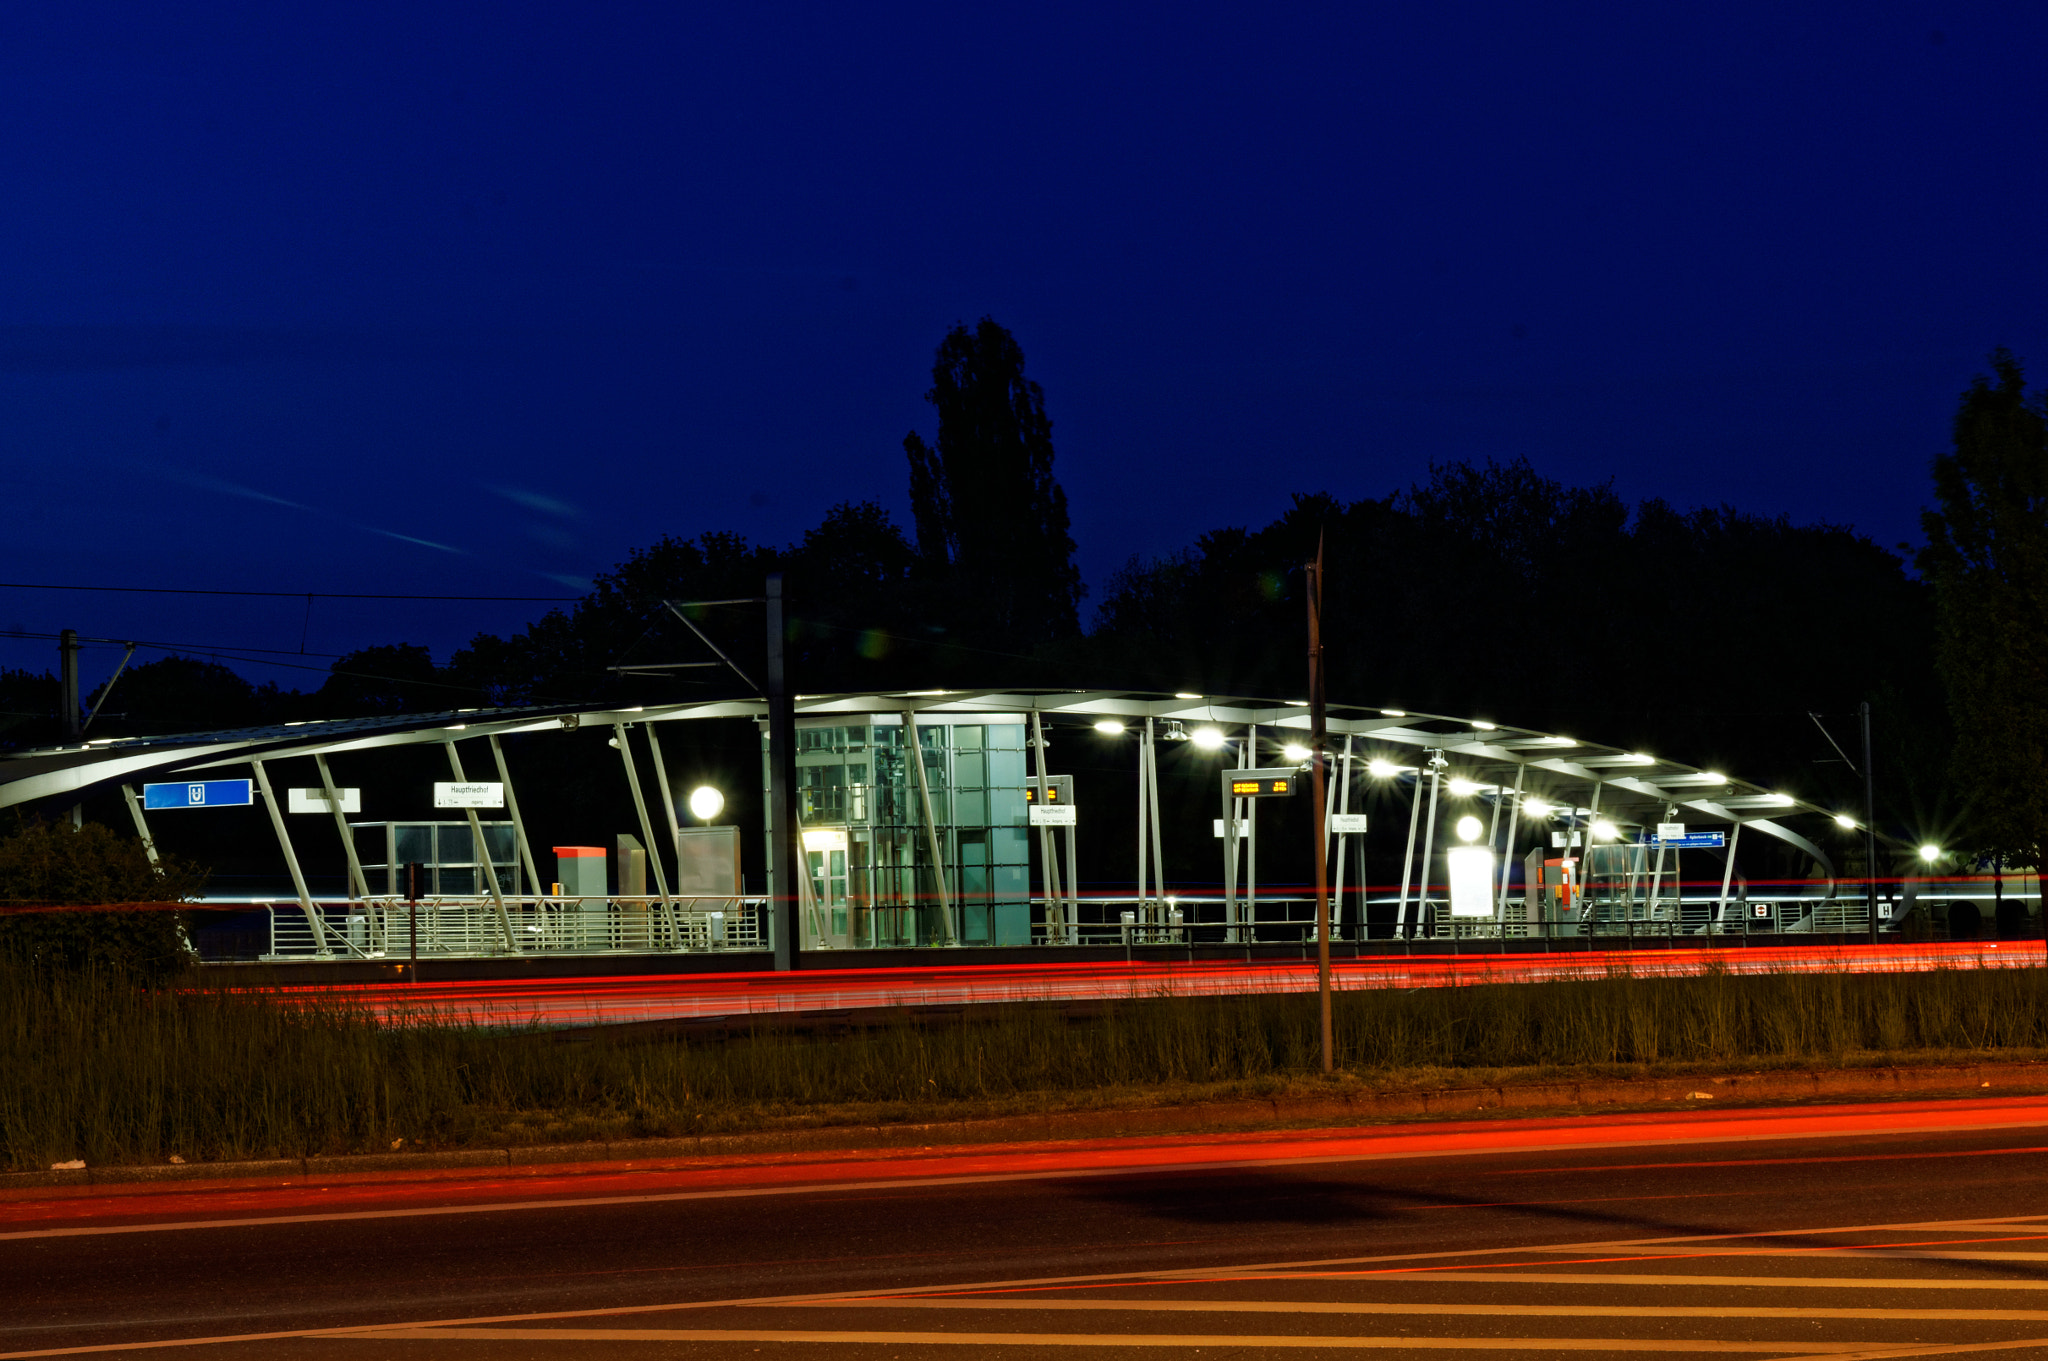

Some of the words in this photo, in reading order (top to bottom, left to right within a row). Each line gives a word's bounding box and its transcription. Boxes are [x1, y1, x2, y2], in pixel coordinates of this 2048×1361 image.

[192, 788, 201, 801] U
[451, 785, 489, 794] Hauptfriedhof
[1883, 905, 1890, 916] H
